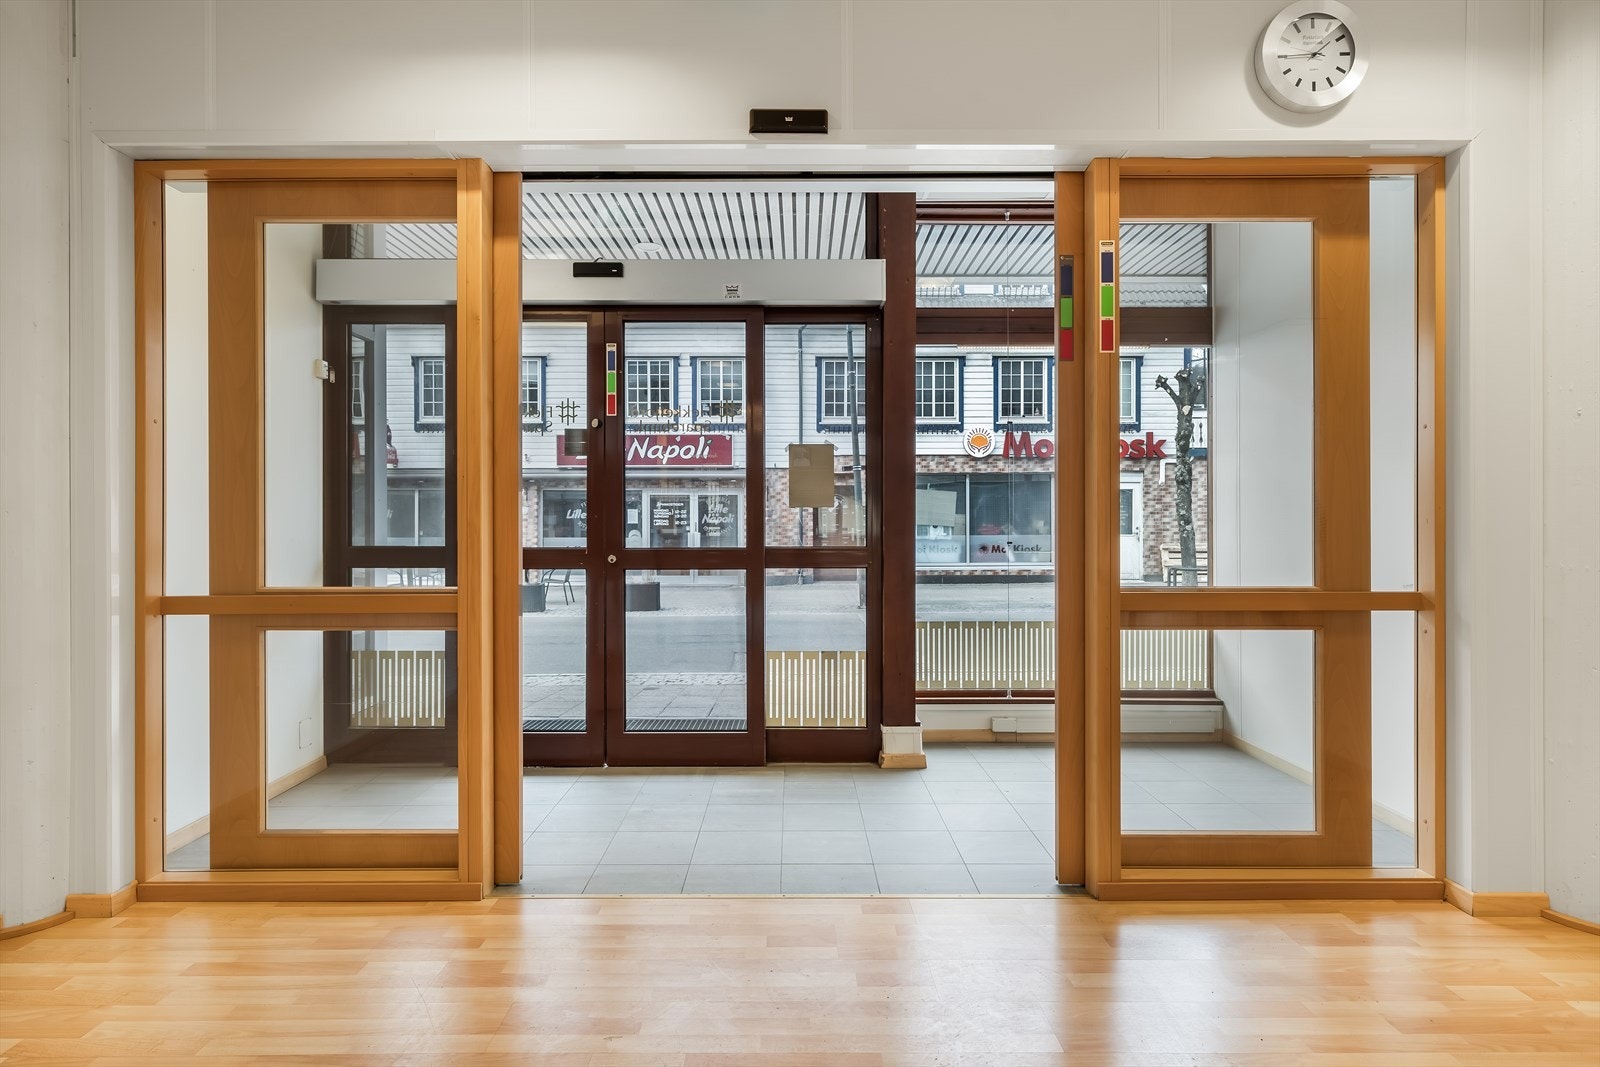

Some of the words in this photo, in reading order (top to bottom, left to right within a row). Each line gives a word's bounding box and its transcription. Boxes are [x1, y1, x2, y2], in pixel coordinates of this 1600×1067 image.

[627, 435, 712, 464] Napoli
[1003, 431, 1054, 459] Mo
[701, 513, 735, 525] Napoli
[928, 545, 958, 554] Kiosk
[1013, 544, 1042, 553] Kiosk
